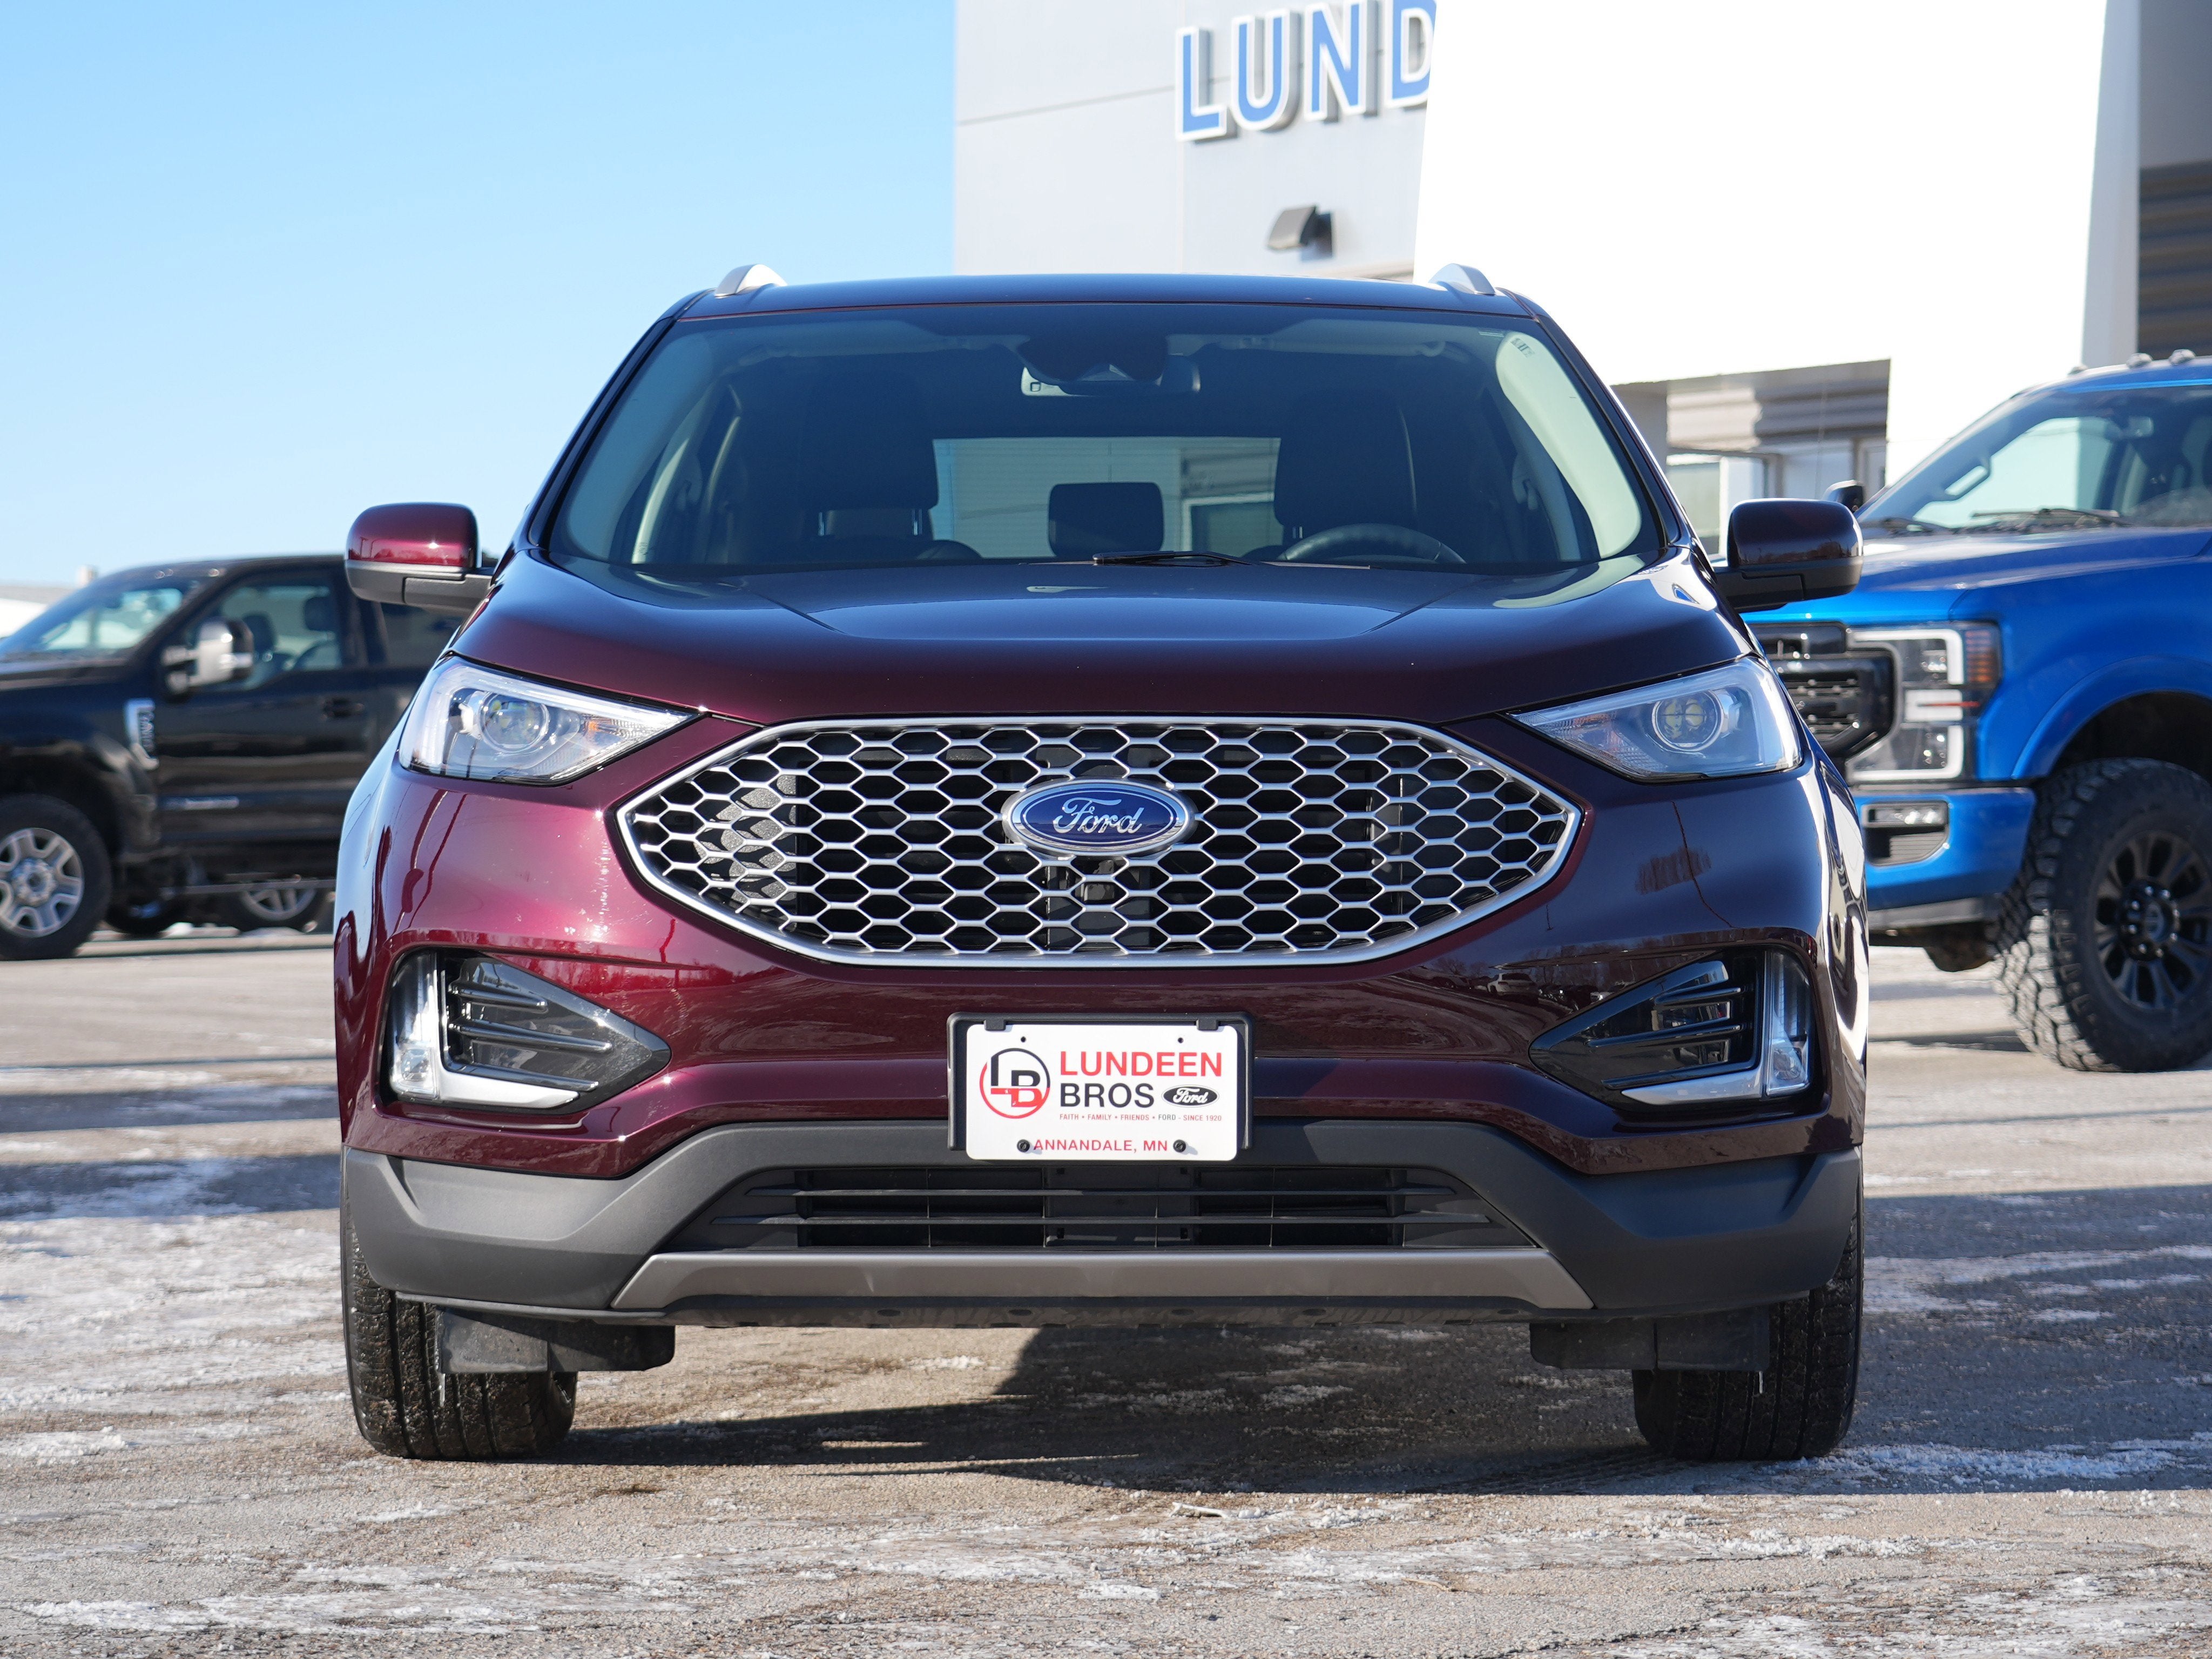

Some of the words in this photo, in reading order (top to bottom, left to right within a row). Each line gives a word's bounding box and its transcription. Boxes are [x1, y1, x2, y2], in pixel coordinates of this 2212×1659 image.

[1177, 0, 1437, 141] LUND
[1053, 797, 1144, 833] Ford
[1061, 1051, 1222, 1076] LUNDEEN
[1060, 1083, 1154, 1108] BROS
[1173, 1087, 1209, 1103] Ford
[1034, 1139, 1137, 1153] ANNANDALE,
[1143, 1140, 1167, 1151] MN
